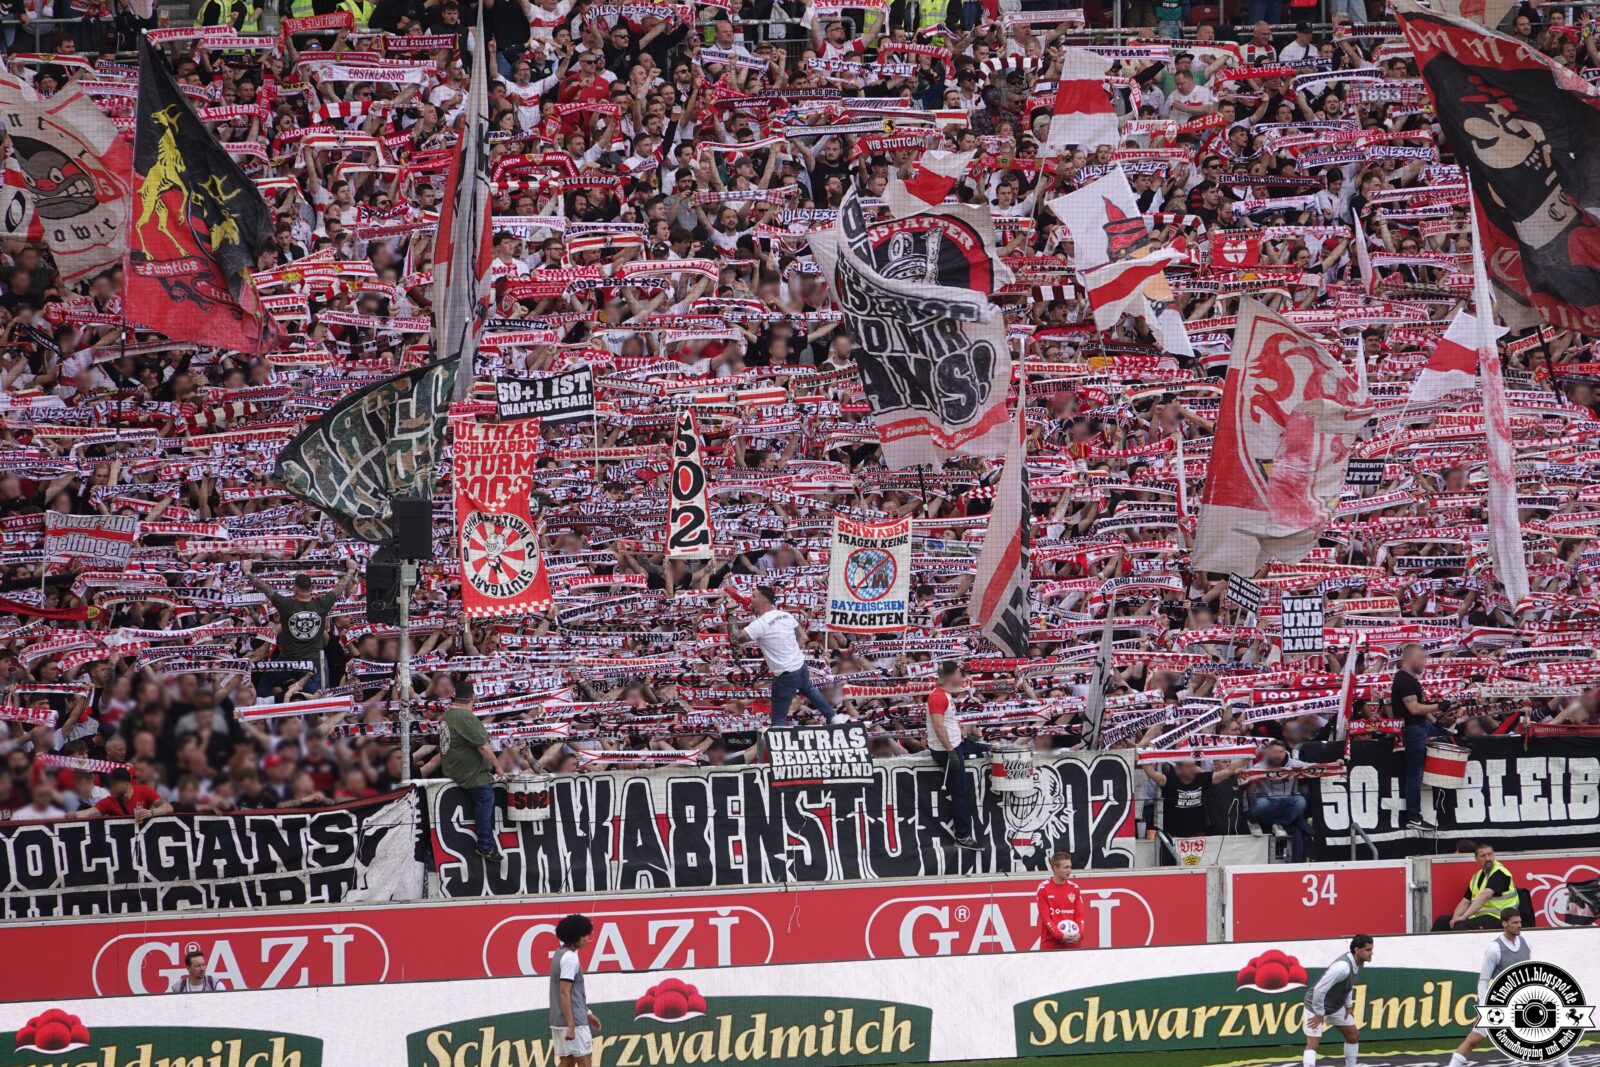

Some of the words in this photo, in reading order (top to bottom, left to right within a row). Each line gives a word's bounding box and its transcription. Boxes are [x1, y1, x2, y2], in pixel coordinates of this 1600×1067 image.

[287, 20, 306, 31] VfB
[309, 14, 348, 29] STUTTGART
[388, 37, 405, 47] VfB
[407, 36, 452, 47] Stuttgart
[348, 67, 406, 81] ERSTKLASSIG
[1360, 88, 1402, 102] 1893
[866, 139, 881, 151] VfB
[882, 136, 925, 149] STUTTGART
[558, 176, 620, 187] STUTTGART
[603, 278, 637, 288] DEM
[667, 331, 680, 339] VfB
[681, 328, 735, 338] STUTTGART
[498, 377, 544, 403] 50+1
[551, 371, 591, 397] IST
[501, 395, 593, 417] UNANTASTBAR!
[453, 418, 541, 441] ULTRAS
[453, 438, 537, 456] SCHWABEN
[453, 452, 535, 476] STURM
[650, 463, 669, 472] VfB
[1345, 470, 1383, 482] JETZT
[3, 519, 24, 529] VfB
[140, 522, 220, 535] STUTTGART
[837, 518, 909, 540] SCHWABEN
[837, 533, 879, 548] TRAGEN
[881, 534, 909, 549] KEINE
[581, 553, 613, 563] WEISS
[470, 568, 534, 598] STUTTGART
[830, 599, 905, 612] BAYERISCHEN
[1282, 598, 1323, 611] VOGT
[830, 610, 905, 627] TRACHTEN
[1282, 612, 1323, 627] UND
[1282, 627, 1323, 637] ADRION
[1282, 638, 1323, 651] RAUS
[1301, 676, 1328, 687] CC
[1355, 674, 1383, 684] 97
[767, 726, 867, 752] ULTRAS
[770, 747, 870, 766] BEDEUTET
[772, 762, 874, 781] WIDERSTAND
[1454, 756, 1600, 824] BLEIB
[0, 809, 358, 893] OLIGANS
[1302, 873, 1337, 907] 34
